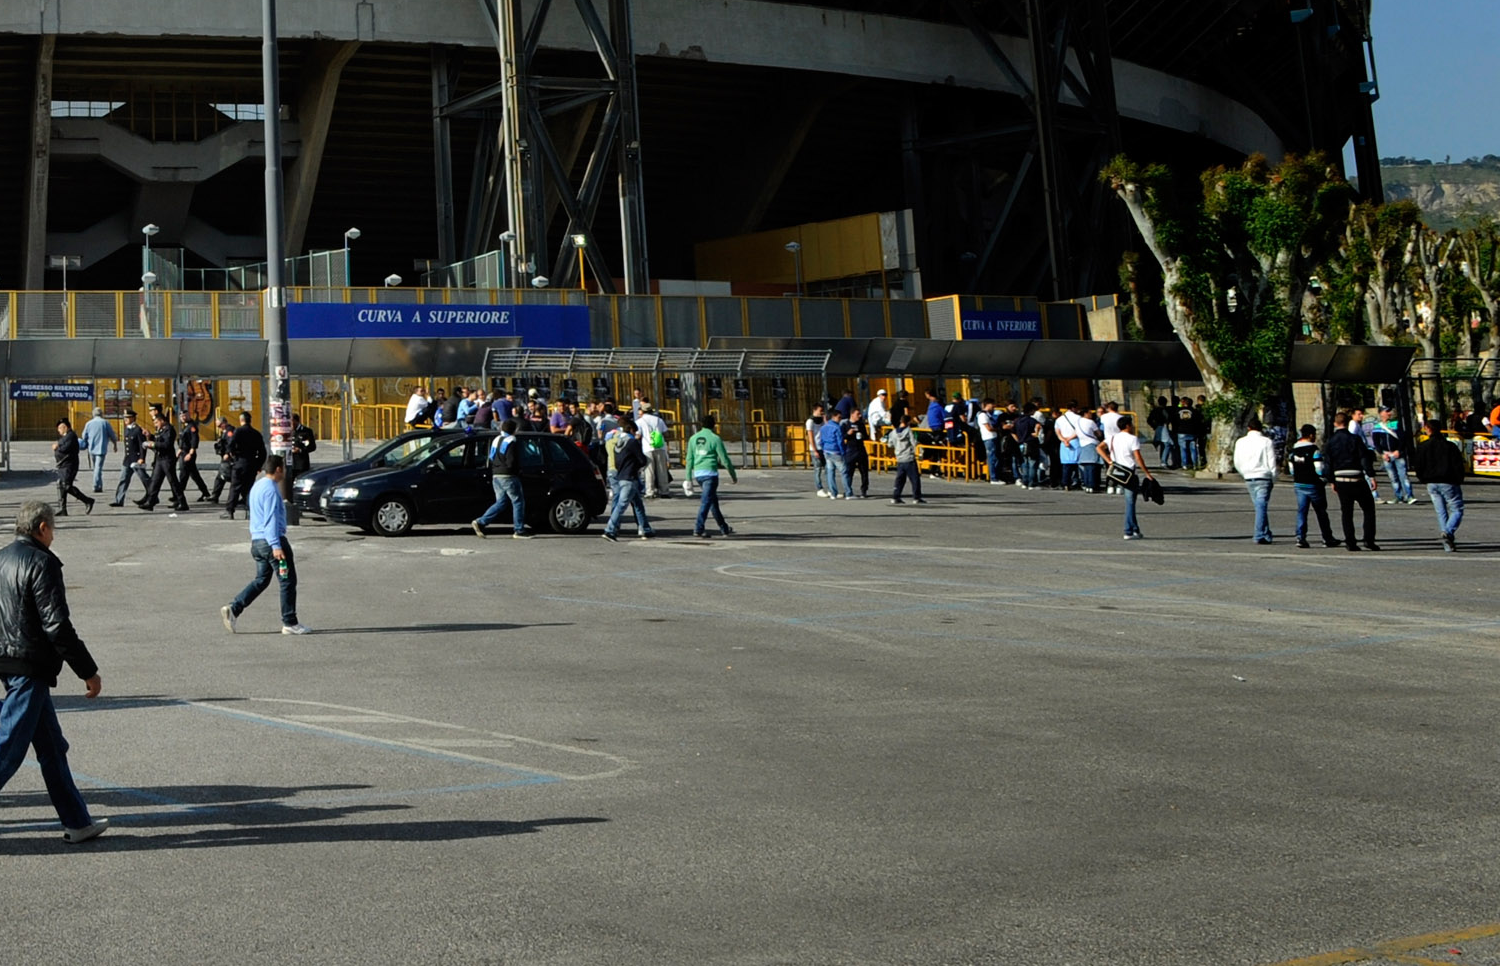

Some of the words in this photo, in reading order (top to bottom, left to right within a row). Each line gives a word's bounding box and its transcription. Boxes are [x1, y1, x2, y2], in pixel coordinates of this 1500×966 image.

[357, 309, 403, 323] CURVA
[411, 310, 422, 323] A
[428, 310, 510, 324] SUPERIORE
[962, 319, 985, 331] CURVA
[987, 320, 993, 331] A
[996, 320, 1037, 332] INFERIORE
